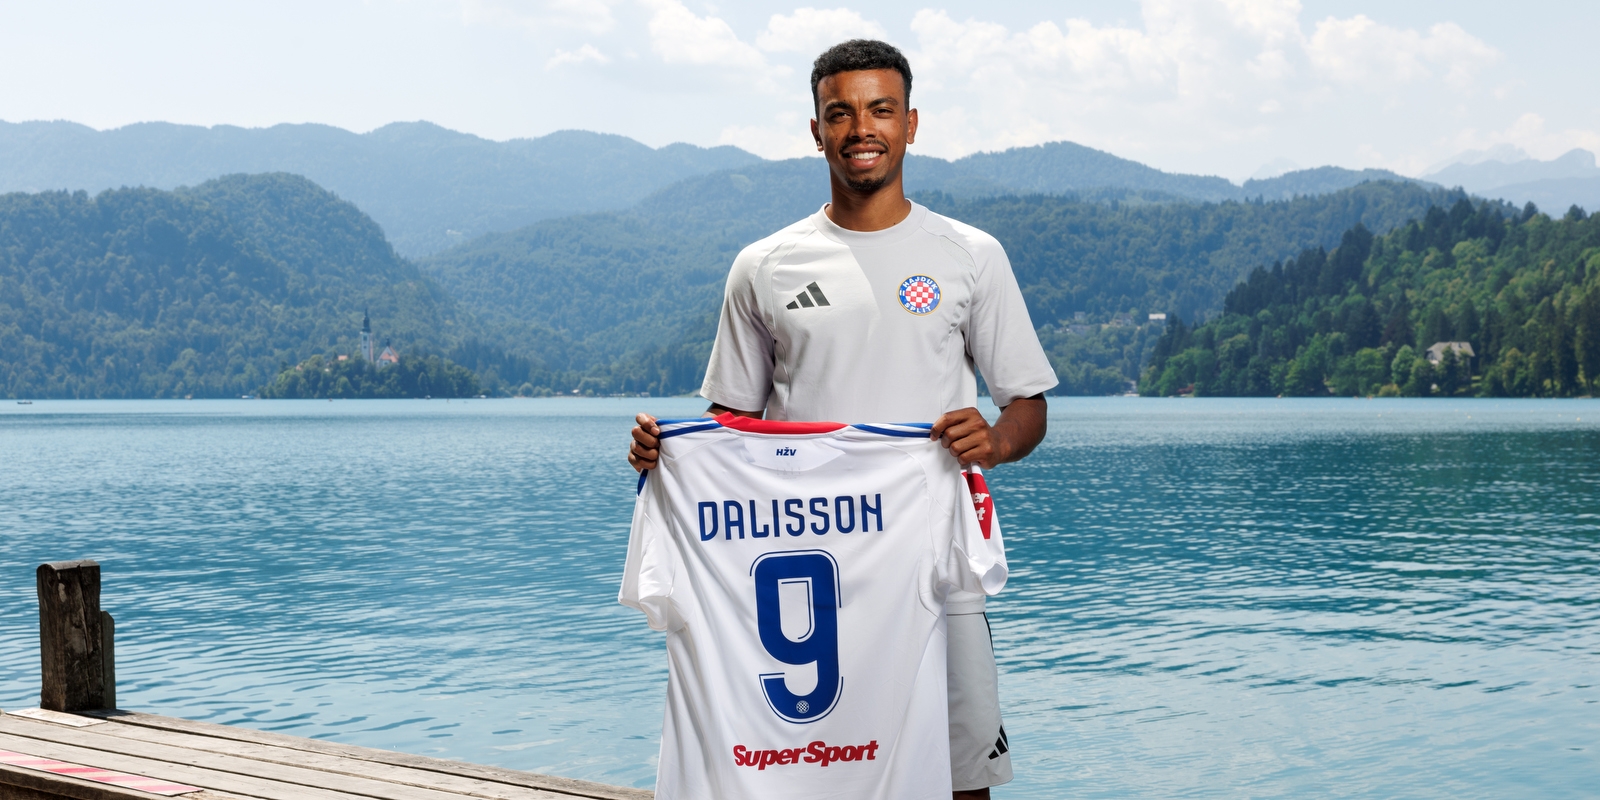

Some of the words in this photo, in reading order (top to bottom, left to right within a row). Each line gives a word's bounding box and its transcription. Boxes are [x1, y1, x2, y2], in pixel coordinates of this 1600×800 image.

[902, 276, 938, 290] HAJDUK
[904, 302, 932, 314] SPLIT
[776, 446, 797, 456] HŽV
[698, 493, 883, 541] DALISSON
[750, 549, 844, 724] 9
[733, 740, 879, 770] SuperSport
